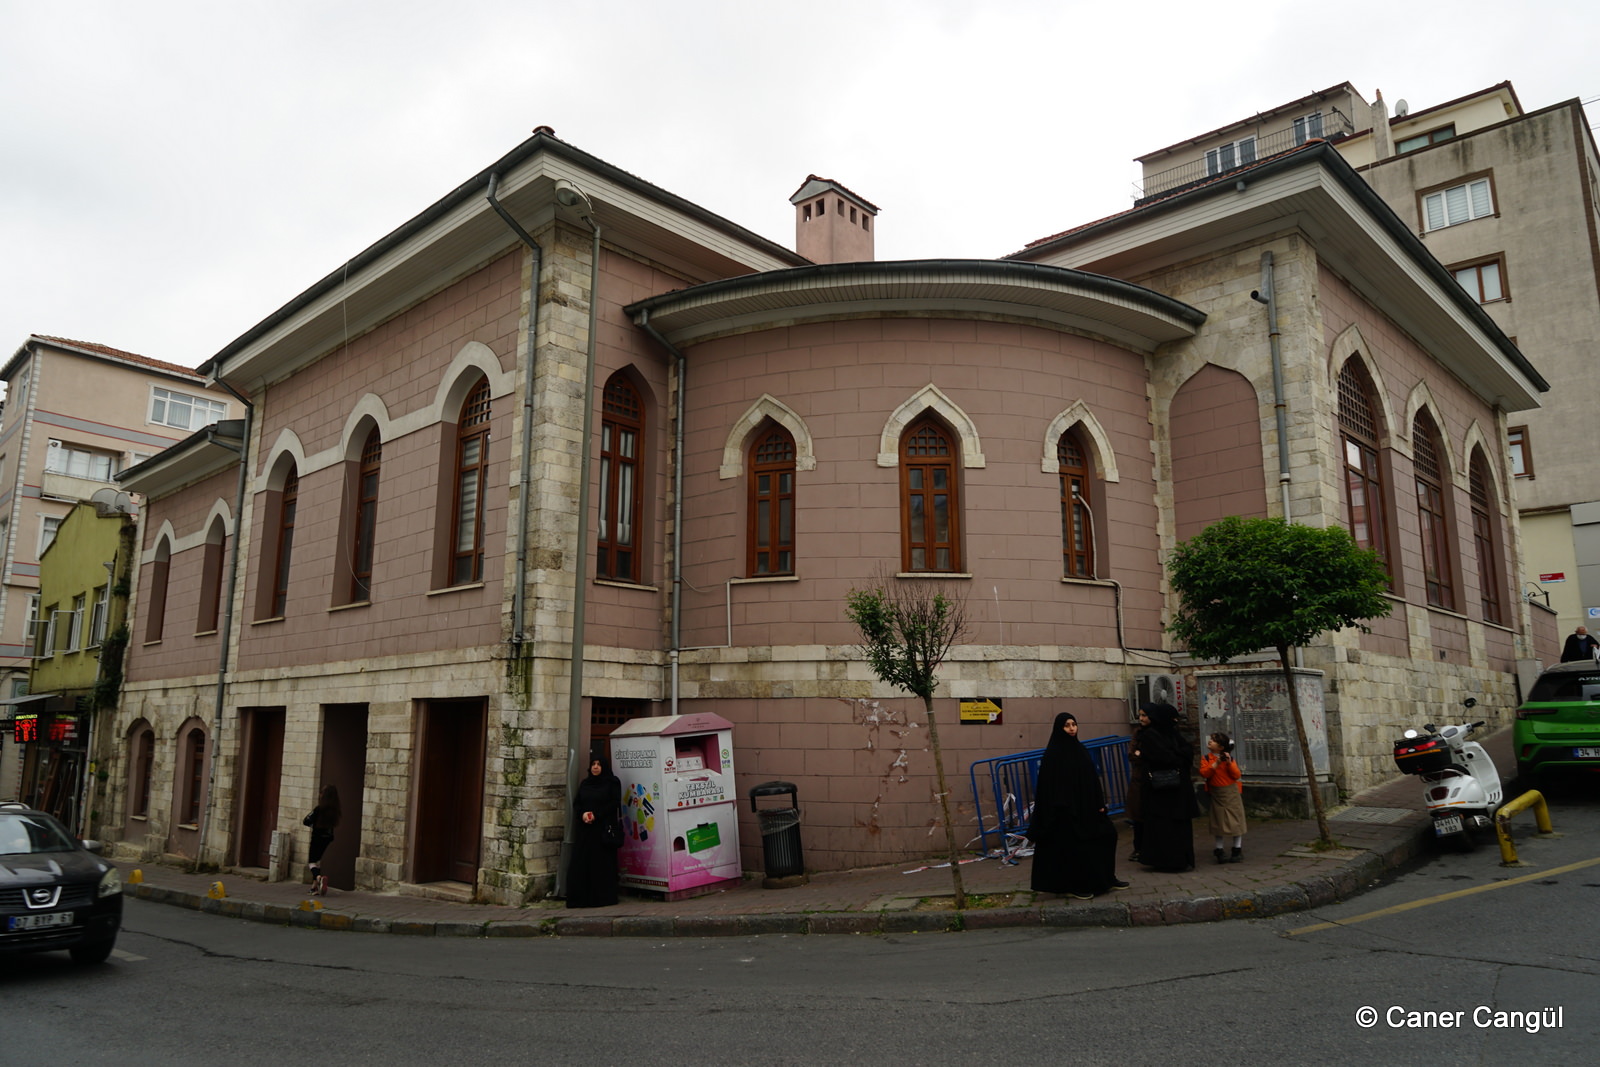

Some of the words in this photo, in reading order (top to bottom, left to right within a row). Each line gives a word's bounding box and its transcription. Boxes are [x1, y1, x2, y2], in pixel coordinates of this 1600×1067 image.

[629, 750, 657, 759] TOPLAMA
[1579, 748, 1590, 757] 34
[620, 759, 653, 769] KUMBARASI
[686, 781, 716, 791] TEKSTİL
[678, 786, 724, 800] KUMBARASI
